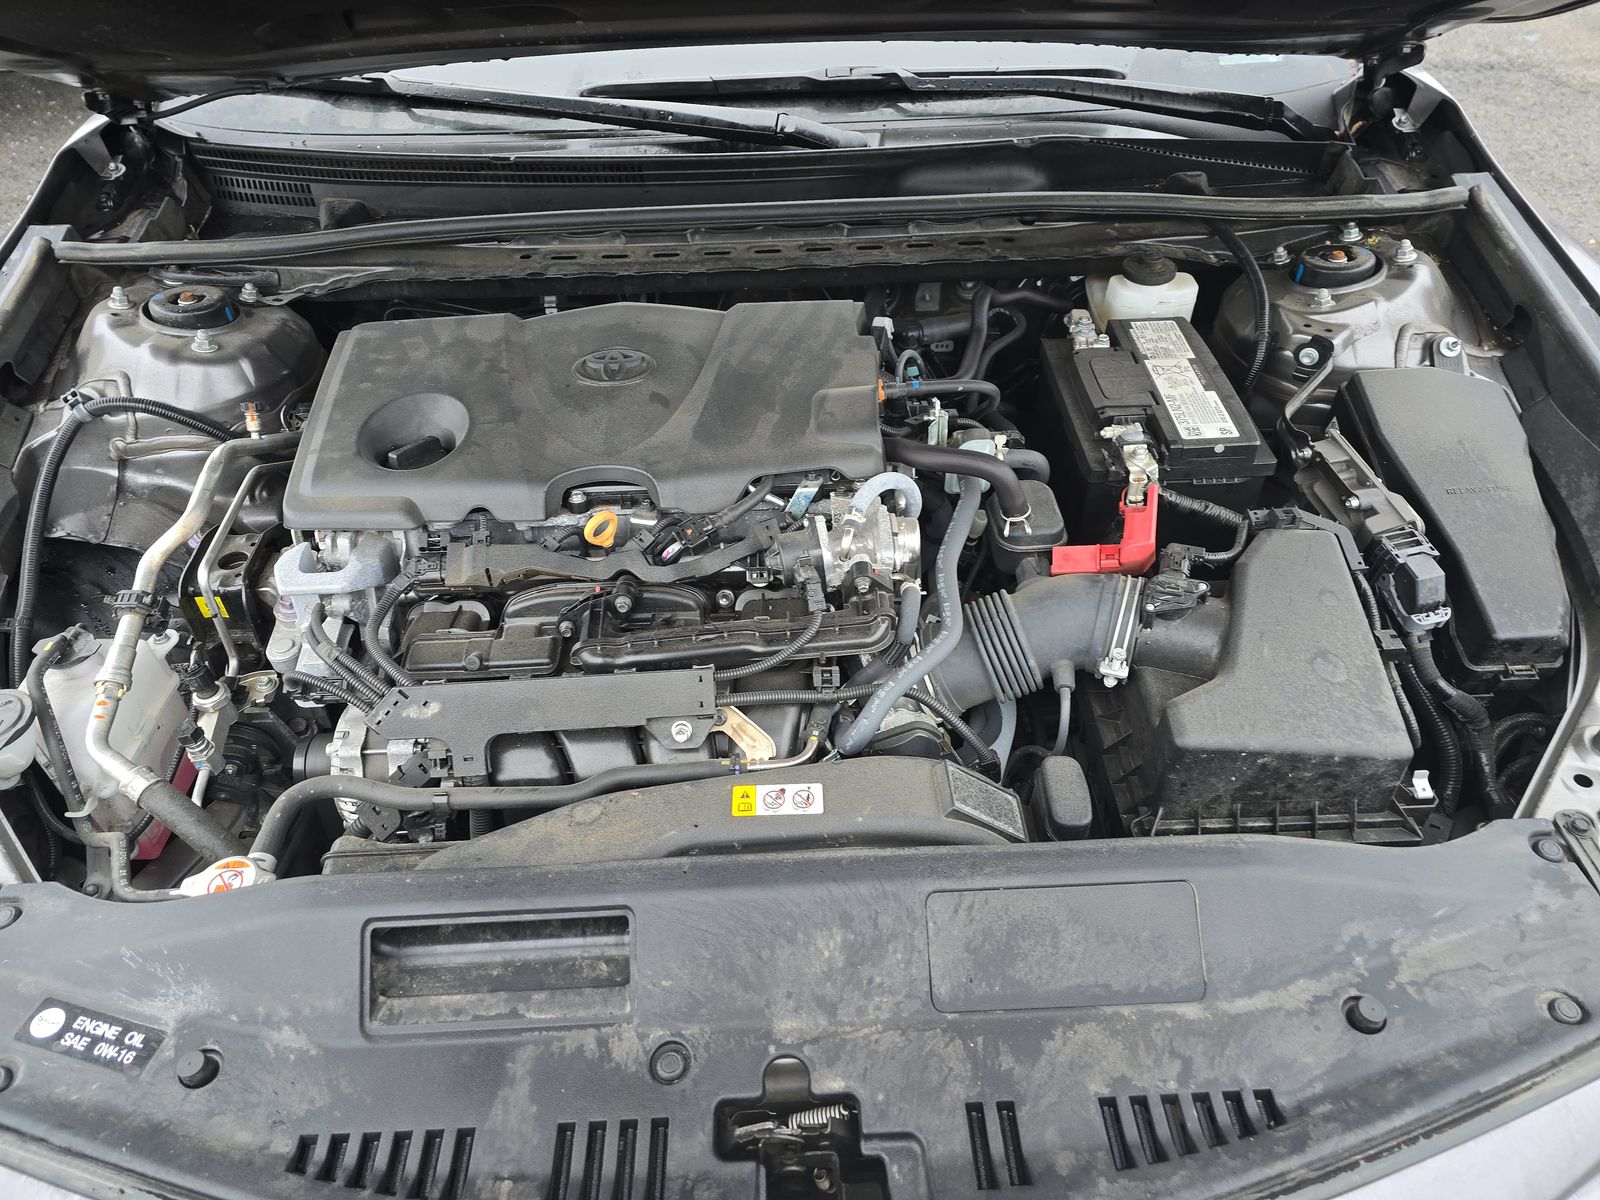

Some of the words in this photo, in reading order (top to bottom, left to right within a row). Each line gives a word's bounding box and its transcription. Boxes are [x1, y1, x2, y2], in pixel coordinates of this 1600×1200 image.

[71, 1015, 123, 1040] ENGINE
[124, 1031, 146, 1048] OIL
[60, 1032, 92, 1051] SAE
[93, 1042, 137, 1064] 0W-16
